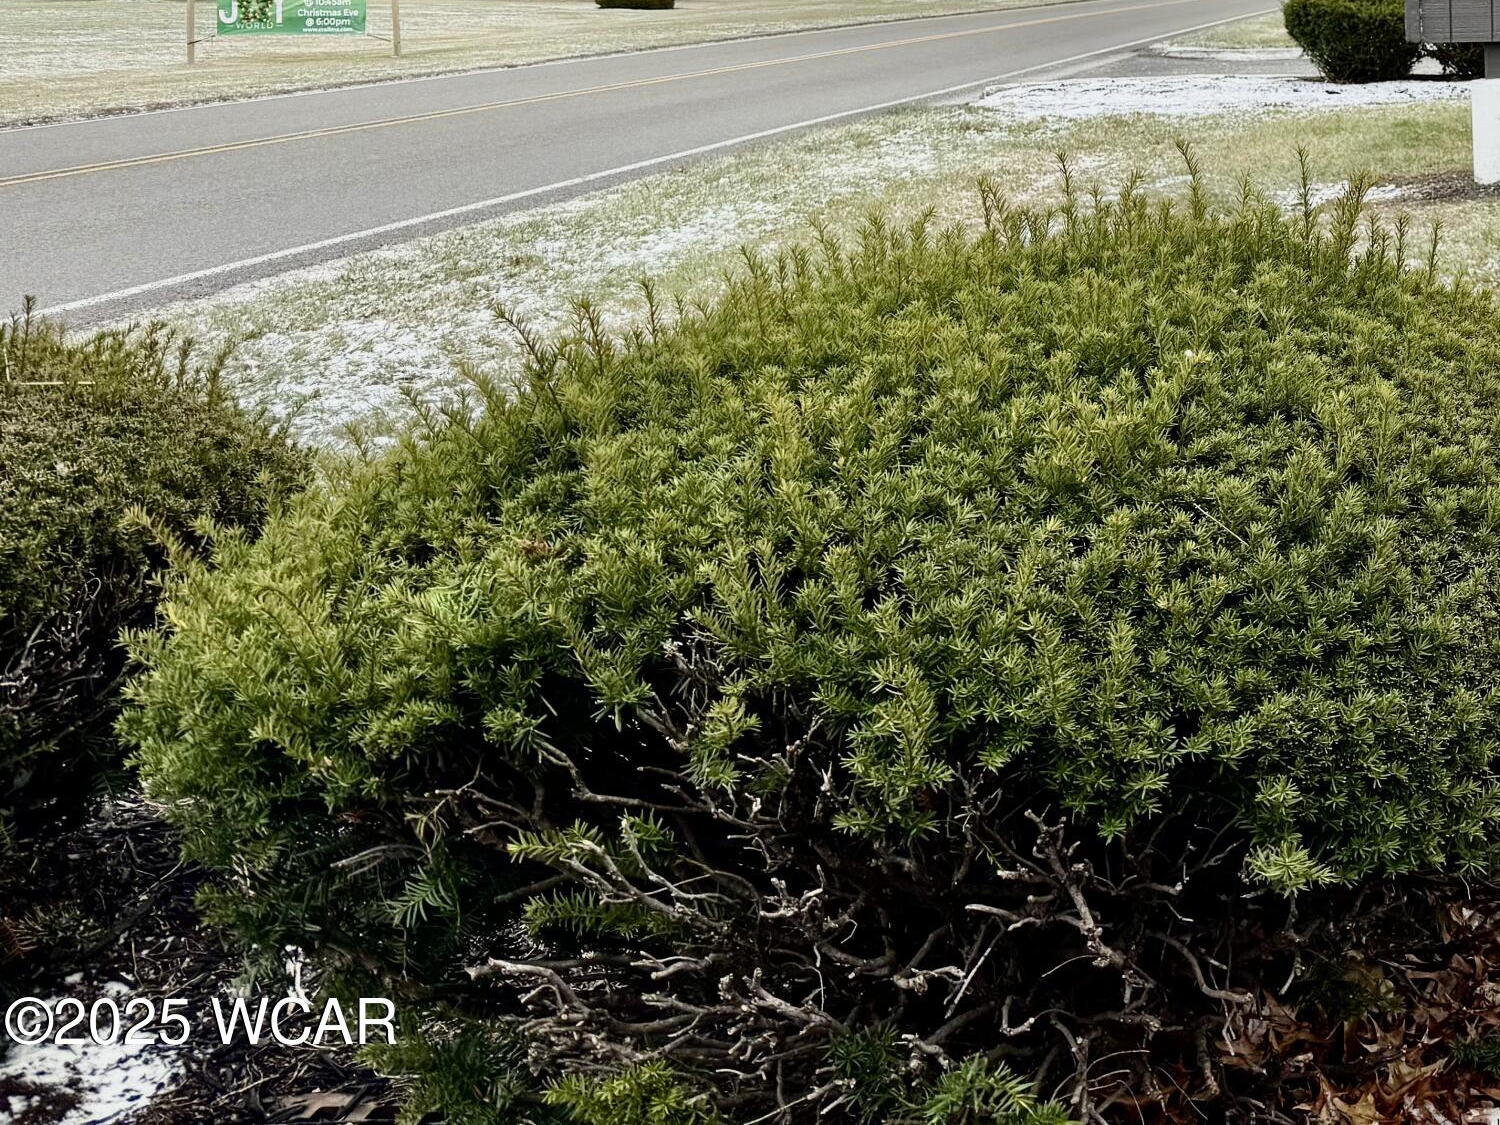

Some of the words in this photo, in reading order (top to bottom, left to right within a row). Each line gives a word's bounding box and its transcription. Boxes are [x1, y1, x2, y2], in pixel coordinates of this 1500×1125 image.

[298, 8, 341, 17] Christmas
[344, 9, 359, 17] Eve
[305, 17, 315, 27] @
[316, 17, 351, 27] 6:00pm
